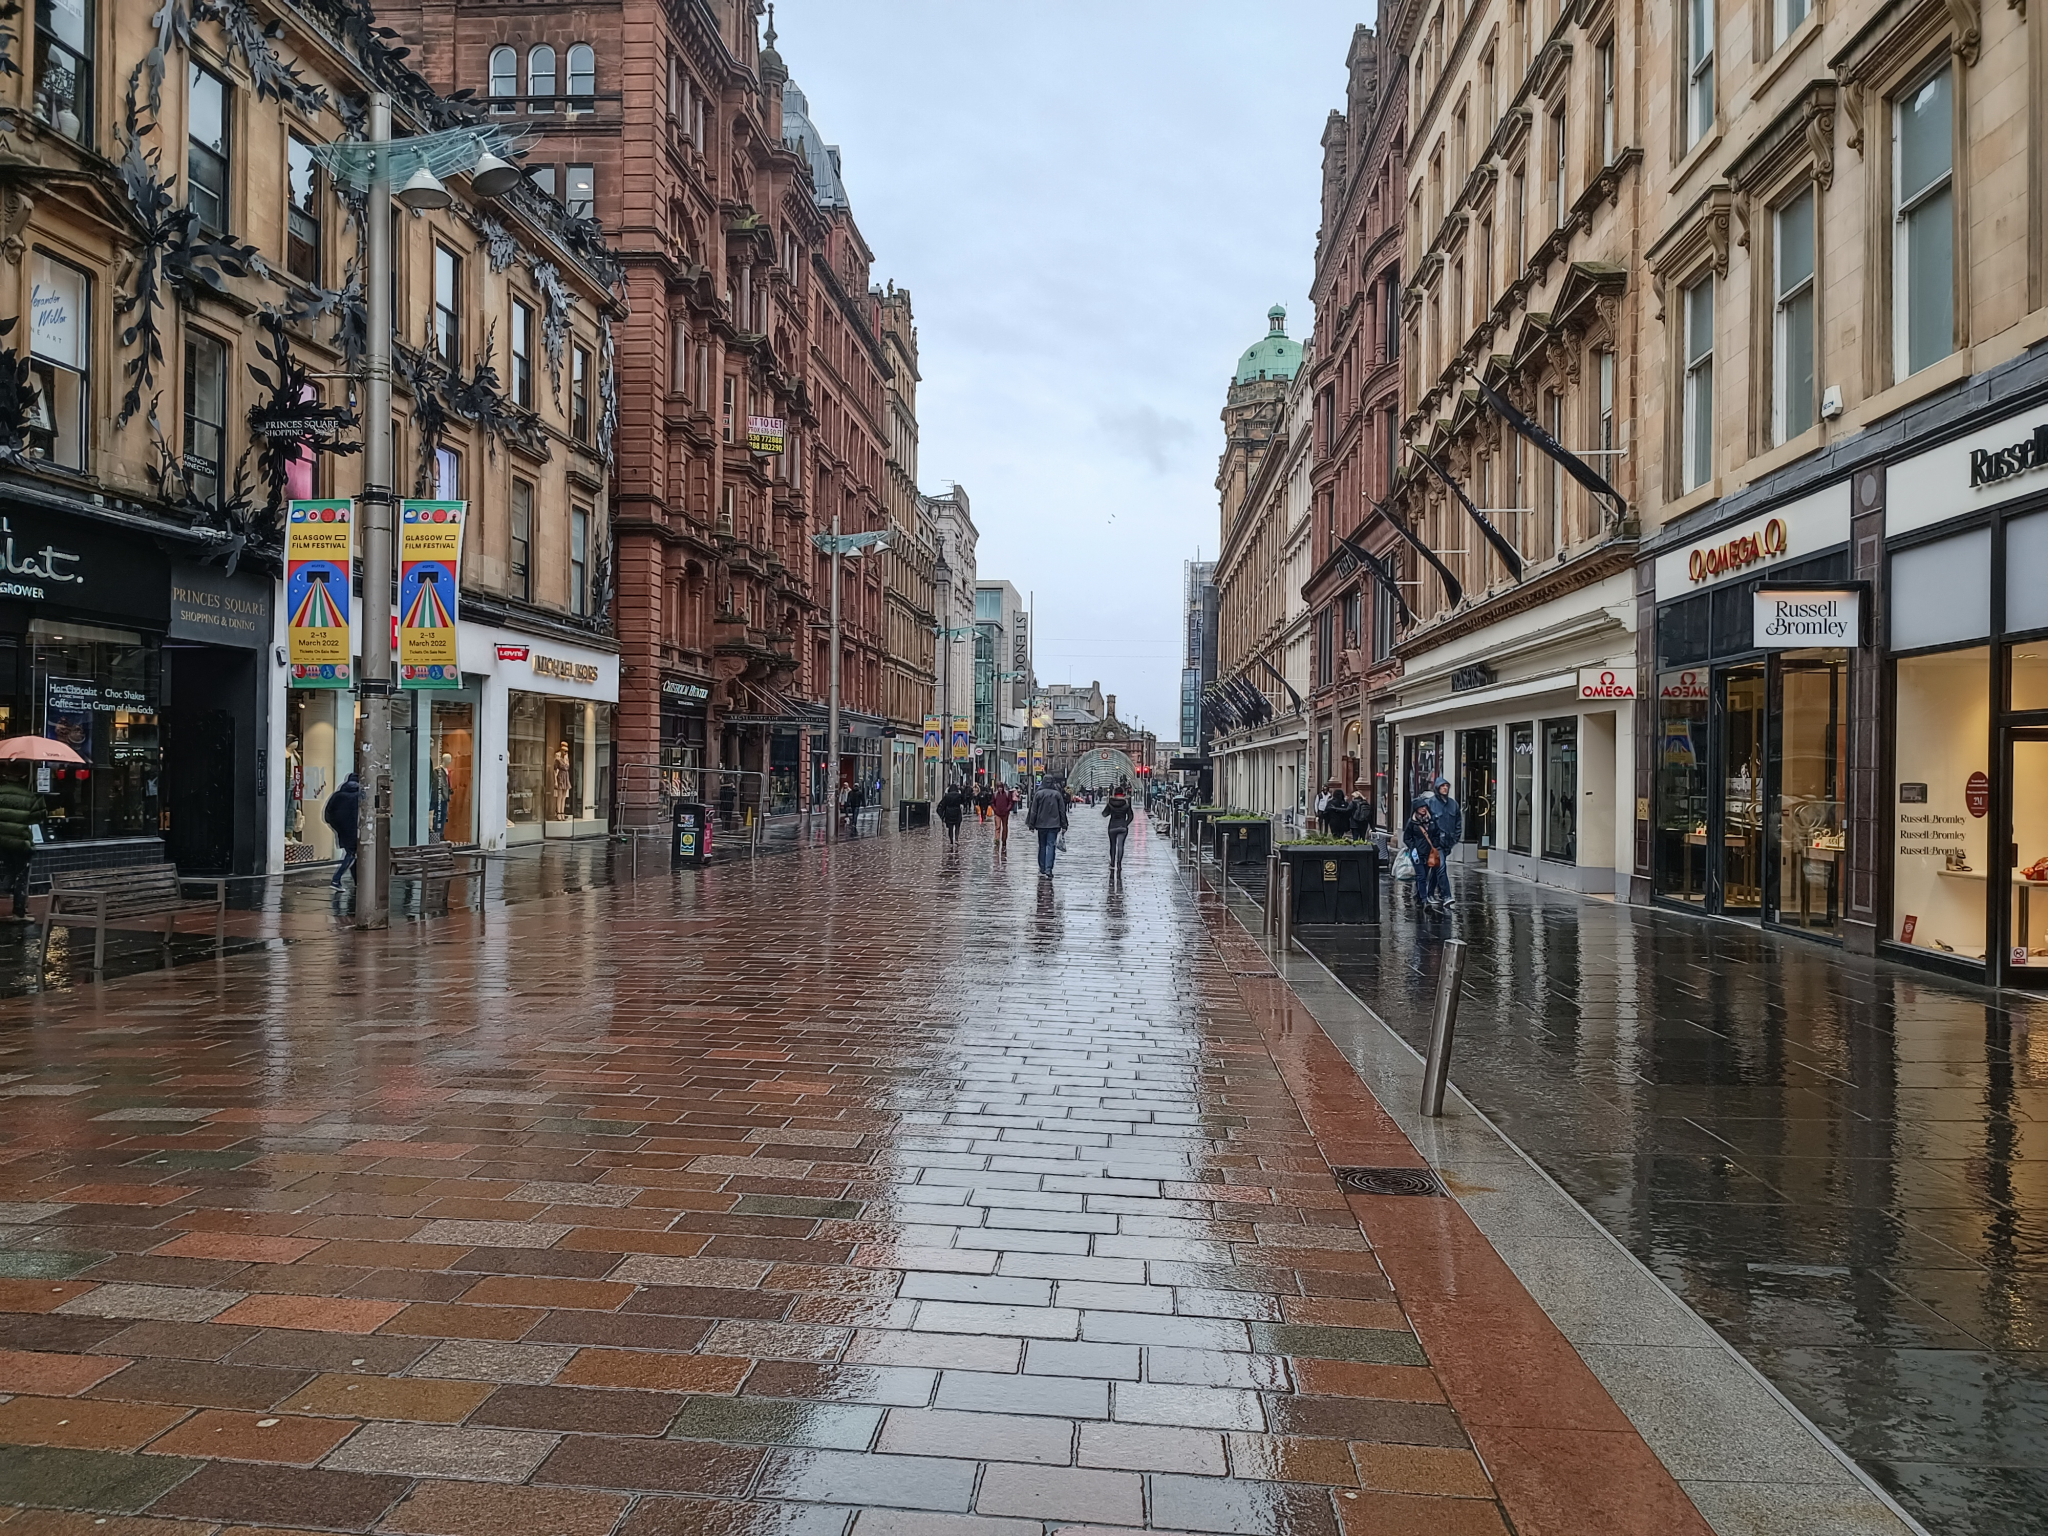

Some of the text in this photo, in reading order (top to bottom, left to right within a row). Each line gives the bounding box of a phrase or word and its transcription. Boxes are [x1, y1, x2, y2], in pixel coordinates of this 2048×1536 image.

[47, 334, 62, 344] ART
[265, 420, 339, 429] PRINCES SQUARE
[760, 418, 769, 427] TO
[771, 419, 782, 429] LET
[265, 429, 304, 437] SHOPPING
[184, 453, 208, 467] FRENCH
[1706, 531, 1766, 575] OMEGA
[173, 586, 267, 617] PRINCES SQUARE
[1775, 600, 1838, 618] Russell
[180, 610, 256, 631] SHOPPING & DINING
[1016, 616, 1026, 632] ST
[311, 631, 327, 639] 2-13
[322, 639, 339, 647] 2022
[409, 639, 430, 647] March
[533, 654, 599, 682] MICHAEL KORS
[66, 684, 98, 697] Chocolat
[104, 688, 123, 700] Choc
[123, 690, 146, 702] Shakes
[1582, 685, 1634, 698] OMEGA
[49, 697, 74, 708] Coffee
[81, 700, 92, 710] Ice
[92, 701, 116, 712] Cream
[117, 703, 125, 712] of
[125, 704, 137, 713] the
[137, 705, 154, 715] Gods
[1900, 814, 1930, 824] Russell
[1900, 830, 1929, 839] Russell
[1900, 846, 1929, 855] Russell
